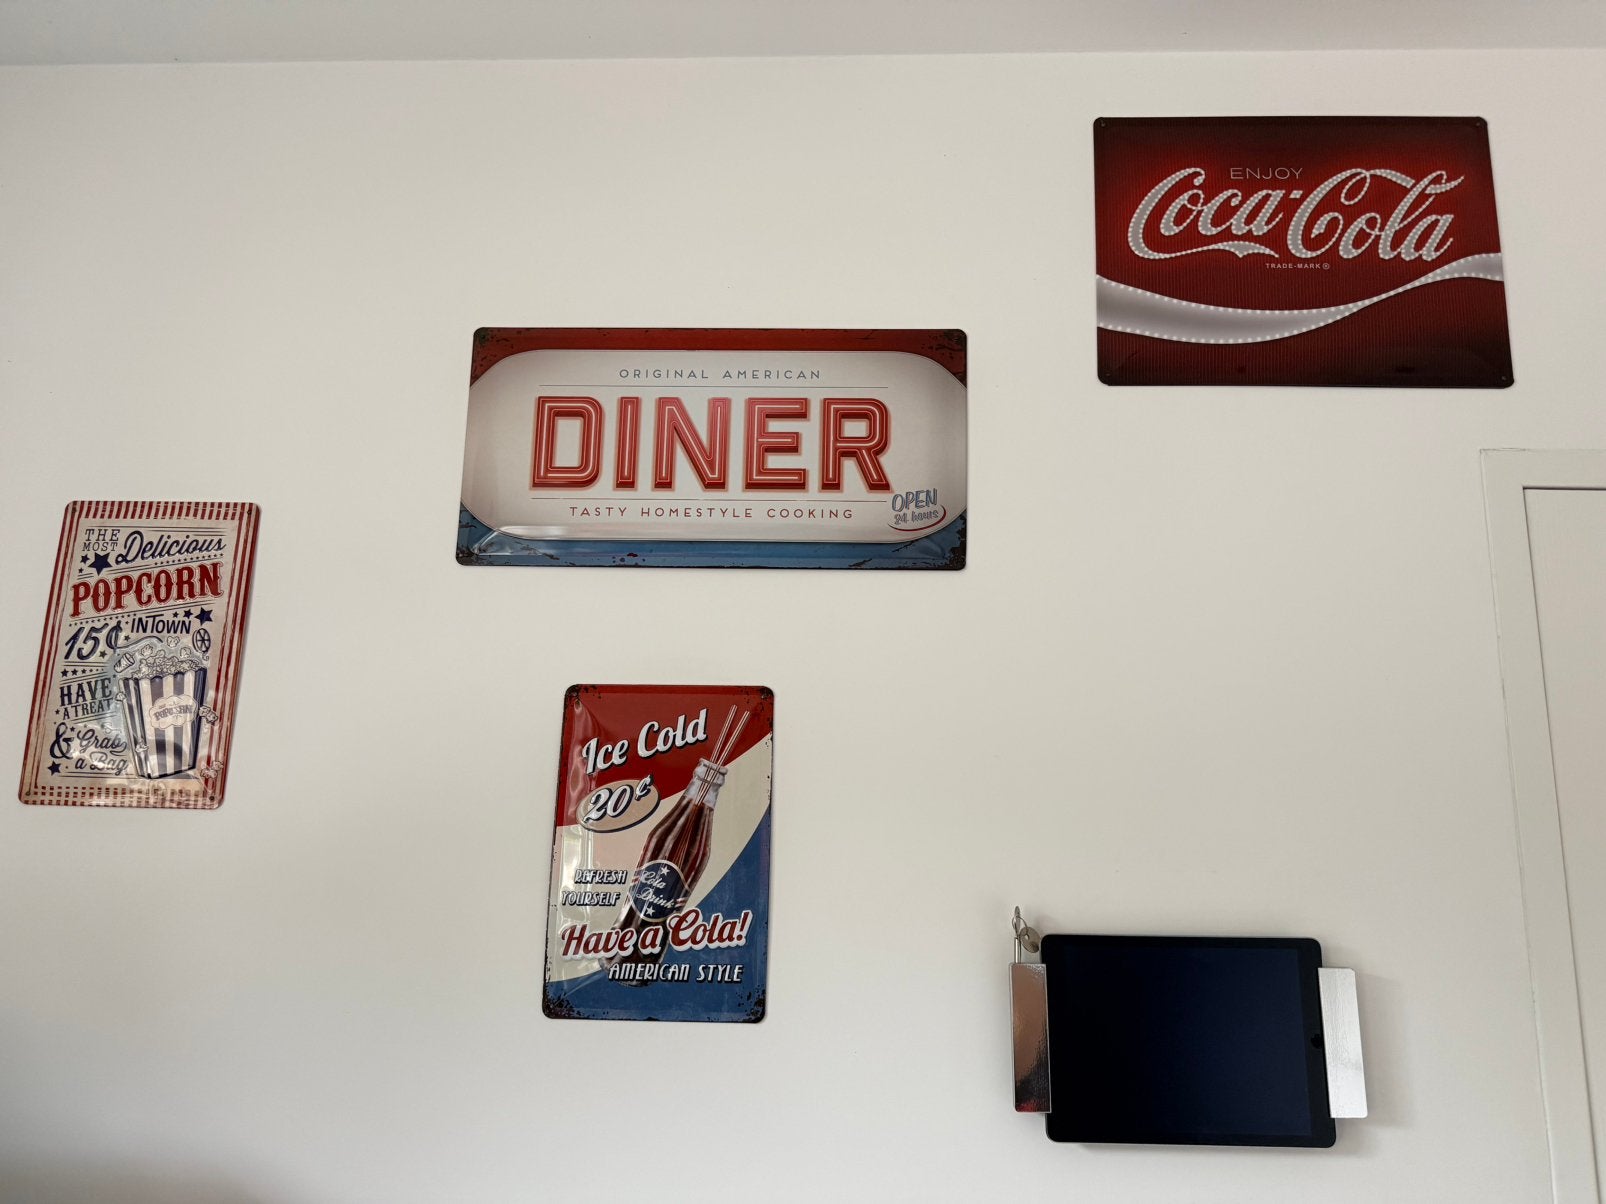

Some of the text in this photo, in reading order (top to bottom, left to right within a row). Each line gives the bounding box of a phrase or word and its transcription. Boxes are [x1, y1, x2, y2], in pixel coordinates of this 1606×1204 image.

[1229, 167, 1303, 180] ENJOY
[1127, 167, 1465, 261] Coca-Cola
[619, 368, 823, 381] ORIGINAL AMERICAN
[530, 395, 895, 494] DINER
[891, 487, 938, 512] OPEN
[569, 505, 854, 521] TASTY HOMESTYLE COOKING
[84, 528, 121, 542] THE
[82, 541, 118, 552] MOST
[115, 530, 227, 566] Delicious
[70, 561, 224, 619] POPCORN
[59, 677, 113, 707] HAVE
[49, 721, 128, 760] & Grab
[582, 708, 708, 776] Ice Cold
[74, 757, 88, 770] a
[574, 868, 628, 886] REFRESH
[561, 890, 621, 908] YOURSELF
[560, 909, 754, 961] Have a Cola!
[608, 963, 744, 983] AMERICAN STYLE
